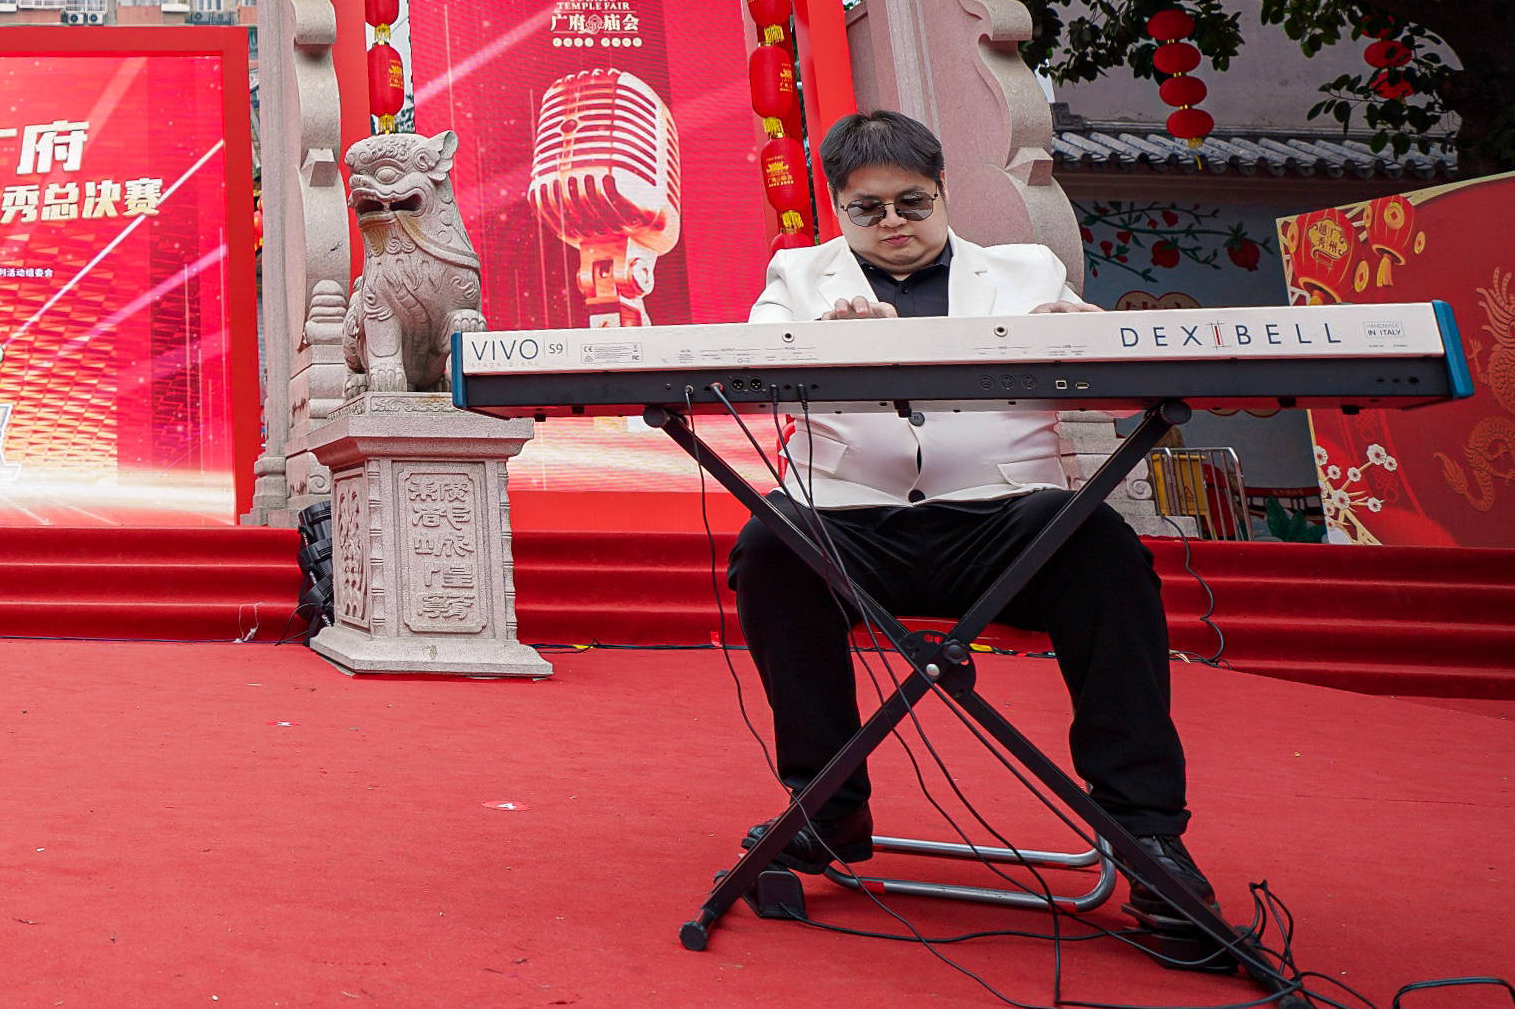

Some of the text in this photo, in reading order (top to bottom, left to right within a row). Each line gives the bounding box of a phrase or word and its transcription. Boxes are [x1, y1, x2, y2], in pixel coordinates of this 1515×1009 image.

[557, 2, 630, 10] TEMPLE FAIR
[1120, 319, 1342, 349] DEXIBELL
[471, 339, 564, 360] VIVO S9
